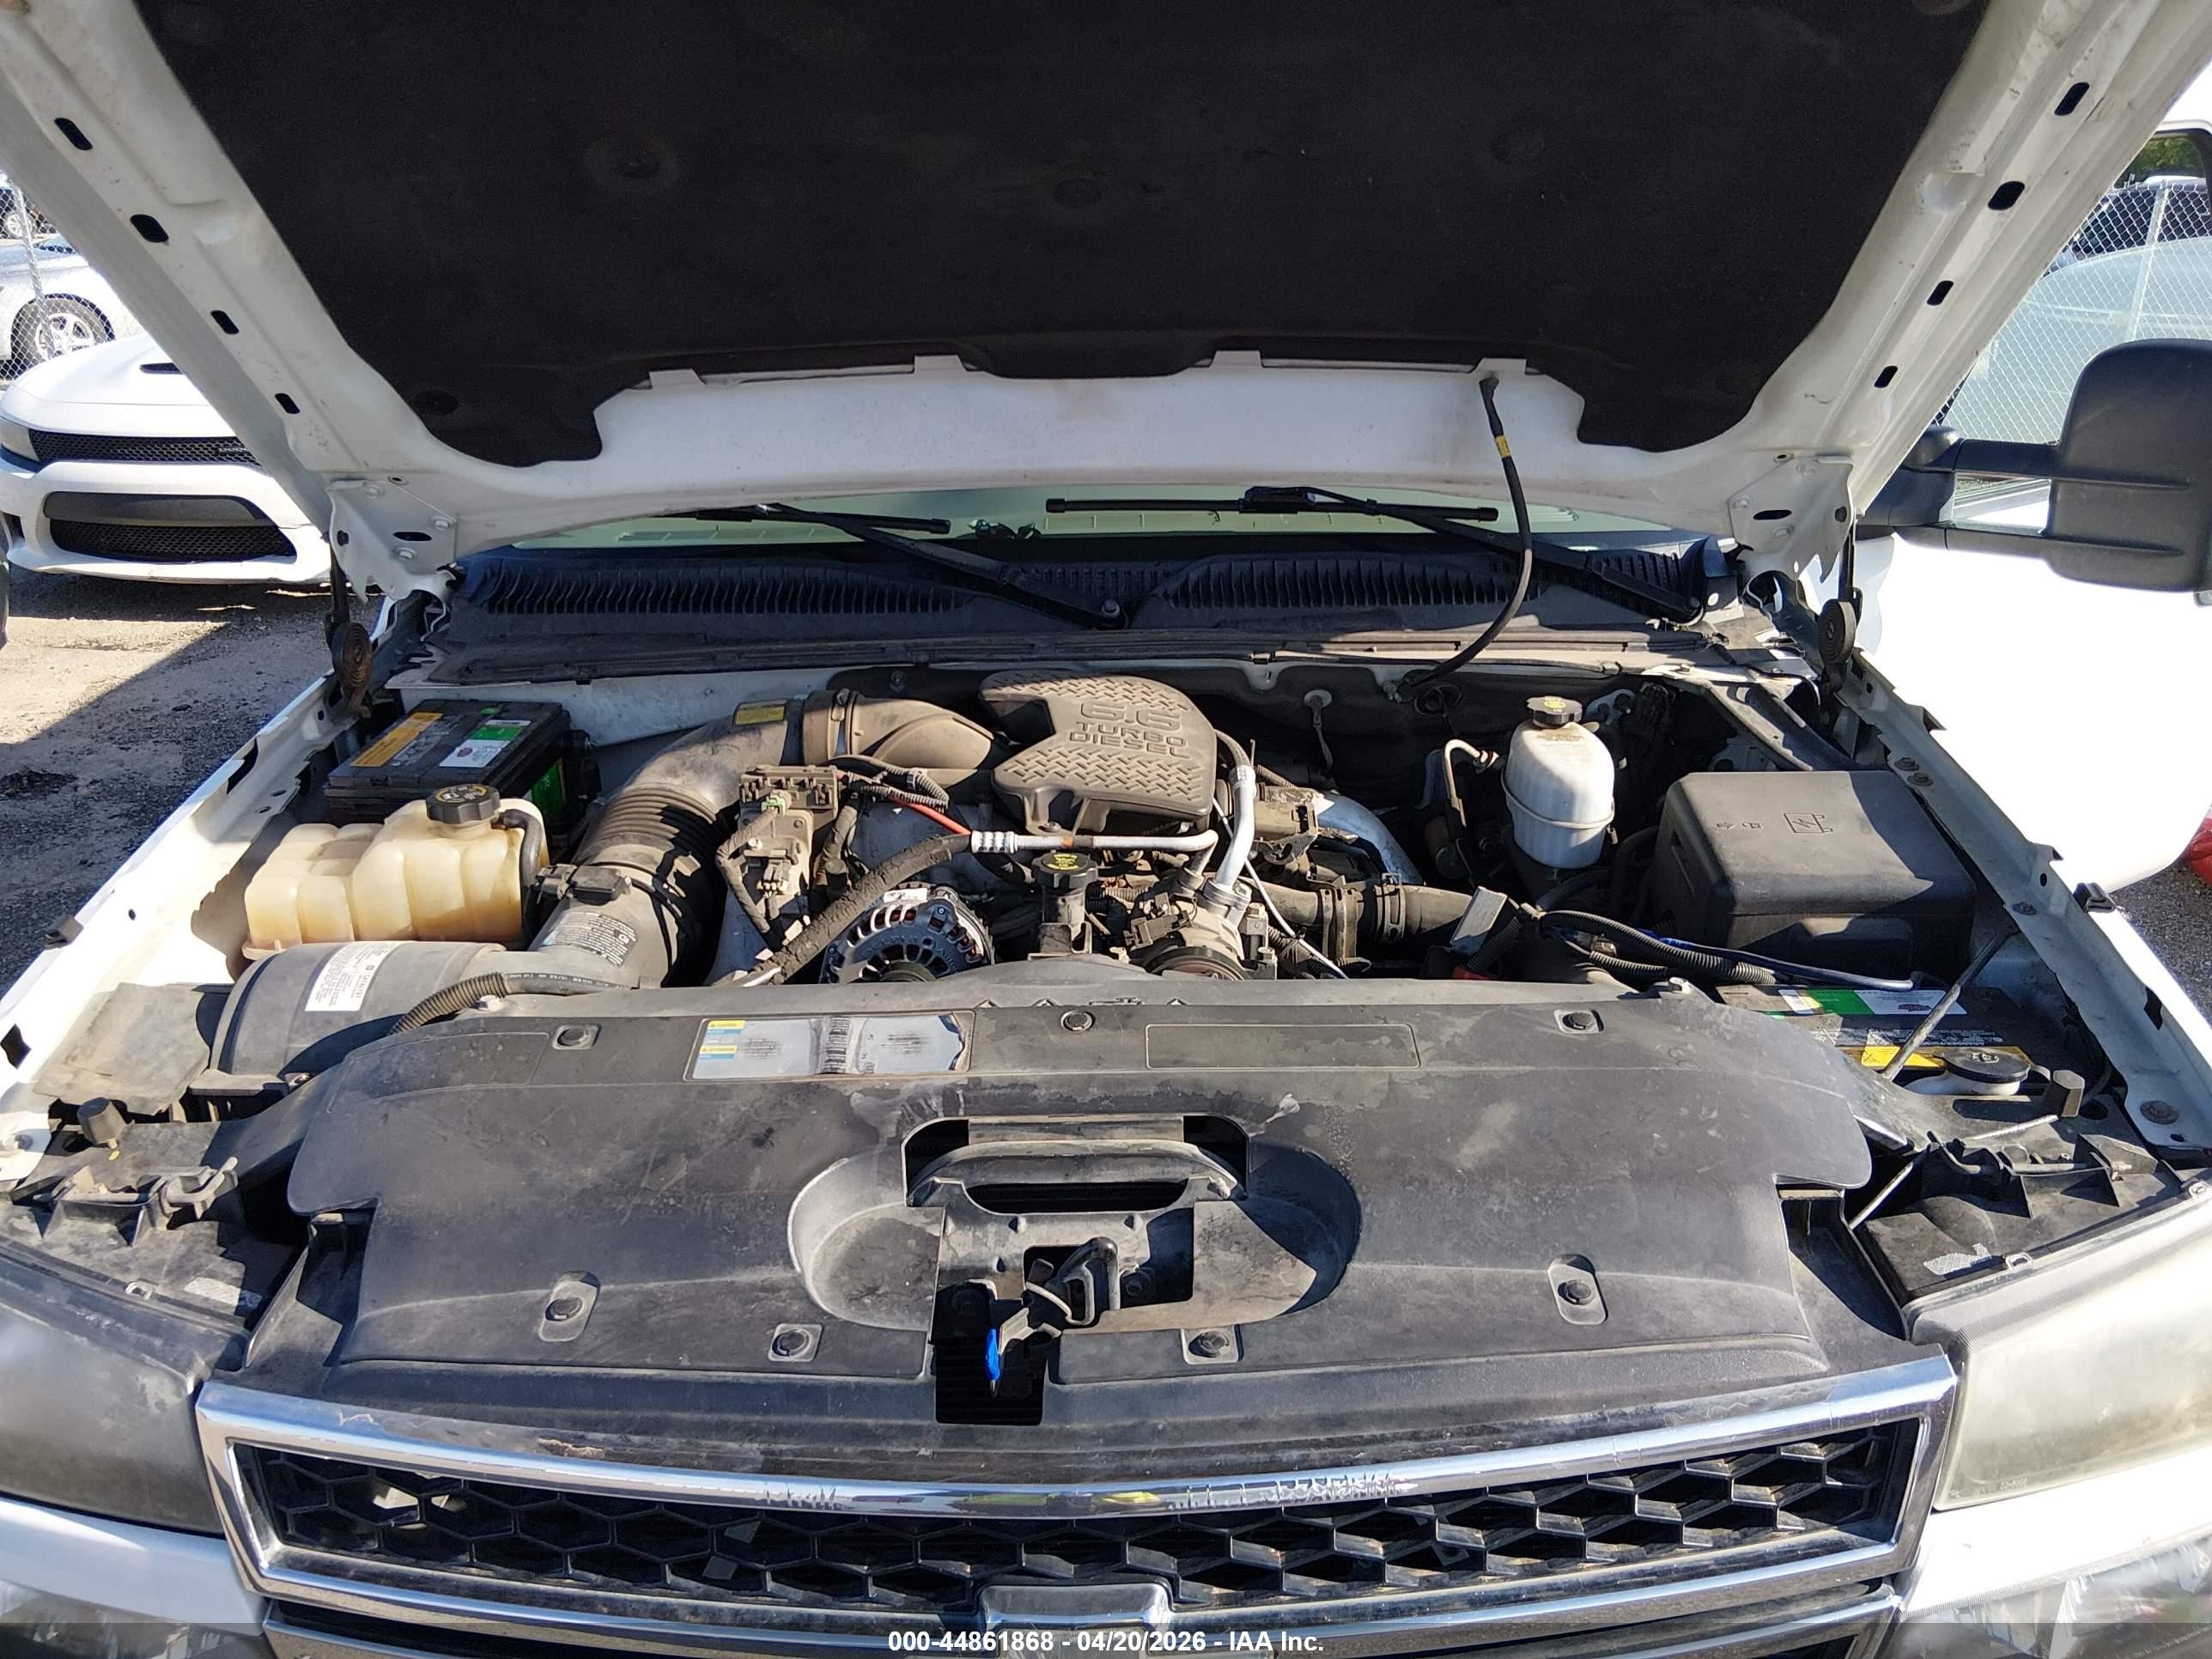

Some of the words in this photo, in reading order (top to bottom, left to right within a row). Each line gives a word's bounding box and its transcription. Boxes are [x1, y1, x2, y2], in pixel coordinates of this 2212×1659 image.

[1079, 702, 1182, 732] 6.6
[1069, 732, 1190, 758] DIESEL
[1075, 721, 1188, 746] TURBO
